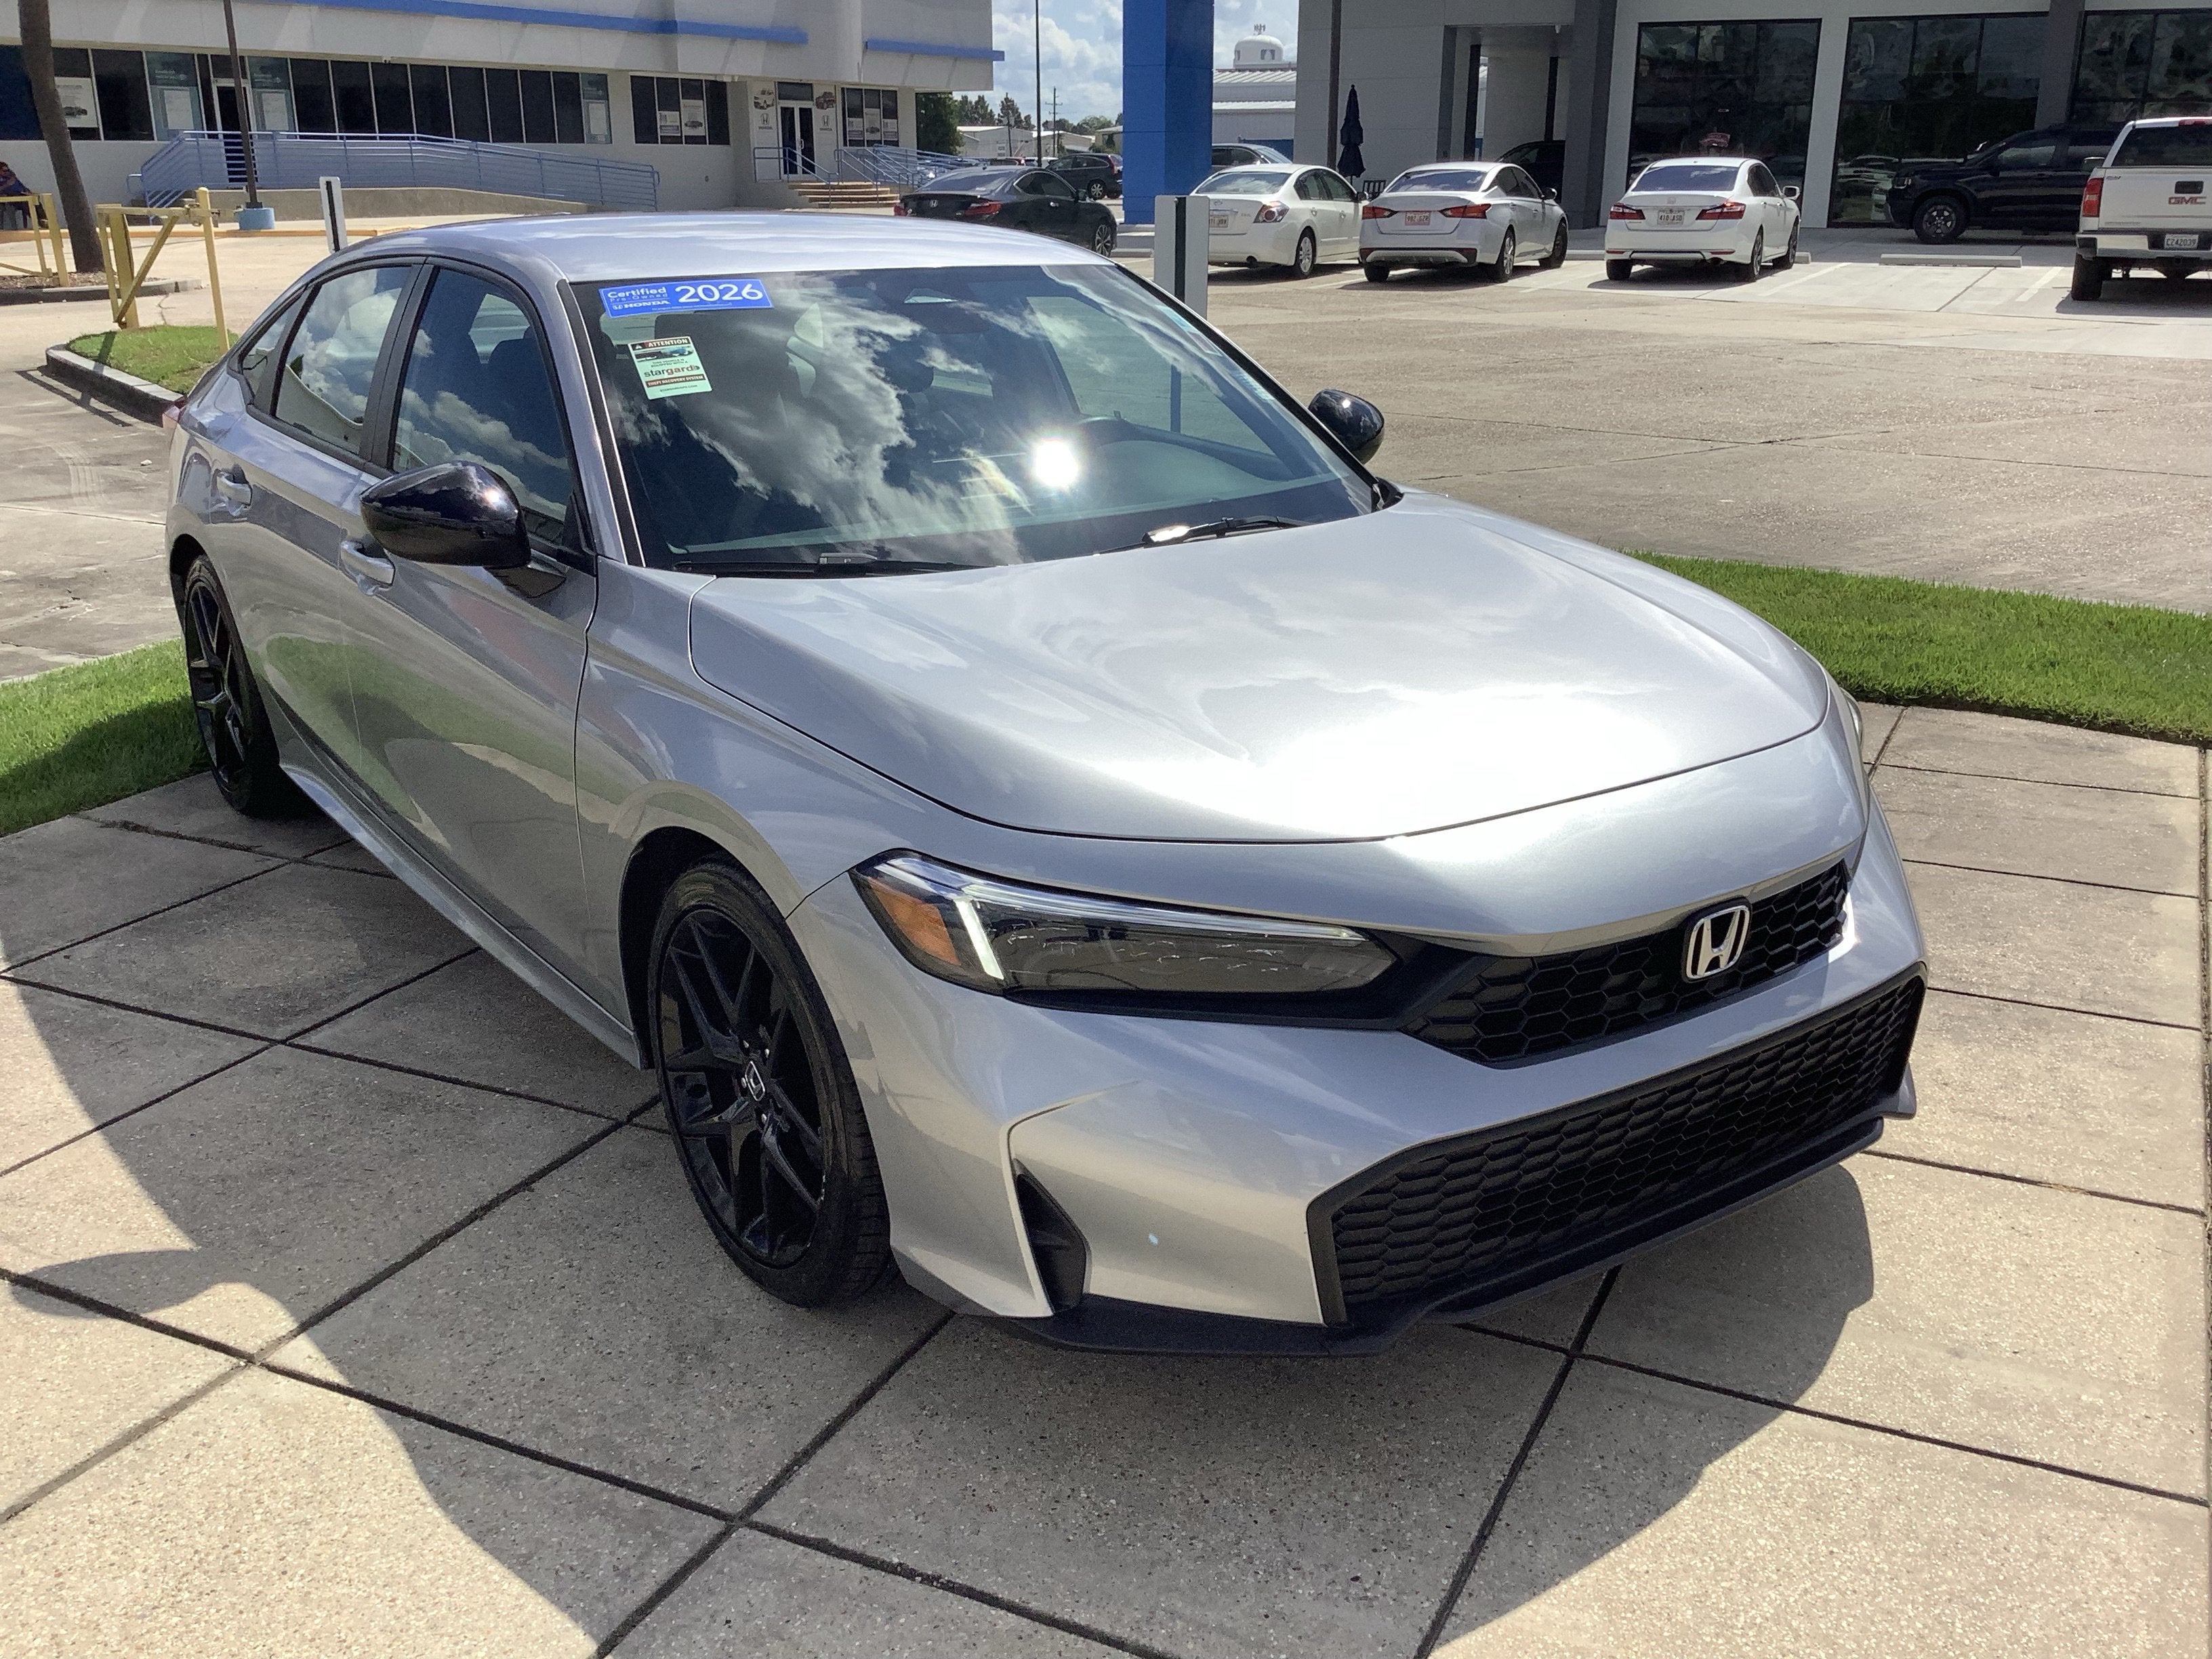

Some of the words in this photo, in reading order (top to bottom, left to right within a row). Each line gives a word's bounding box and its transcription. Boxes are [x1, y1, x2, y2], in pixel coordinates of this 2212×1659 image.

[2168, 196, 2207, 205] GMC
[607, 286, 668, 298] Certified
[675, 283, 764, 303] 2026
[623, 300, 671, 308] HONDA
[648, 338, 688, 348] ATTENTION
